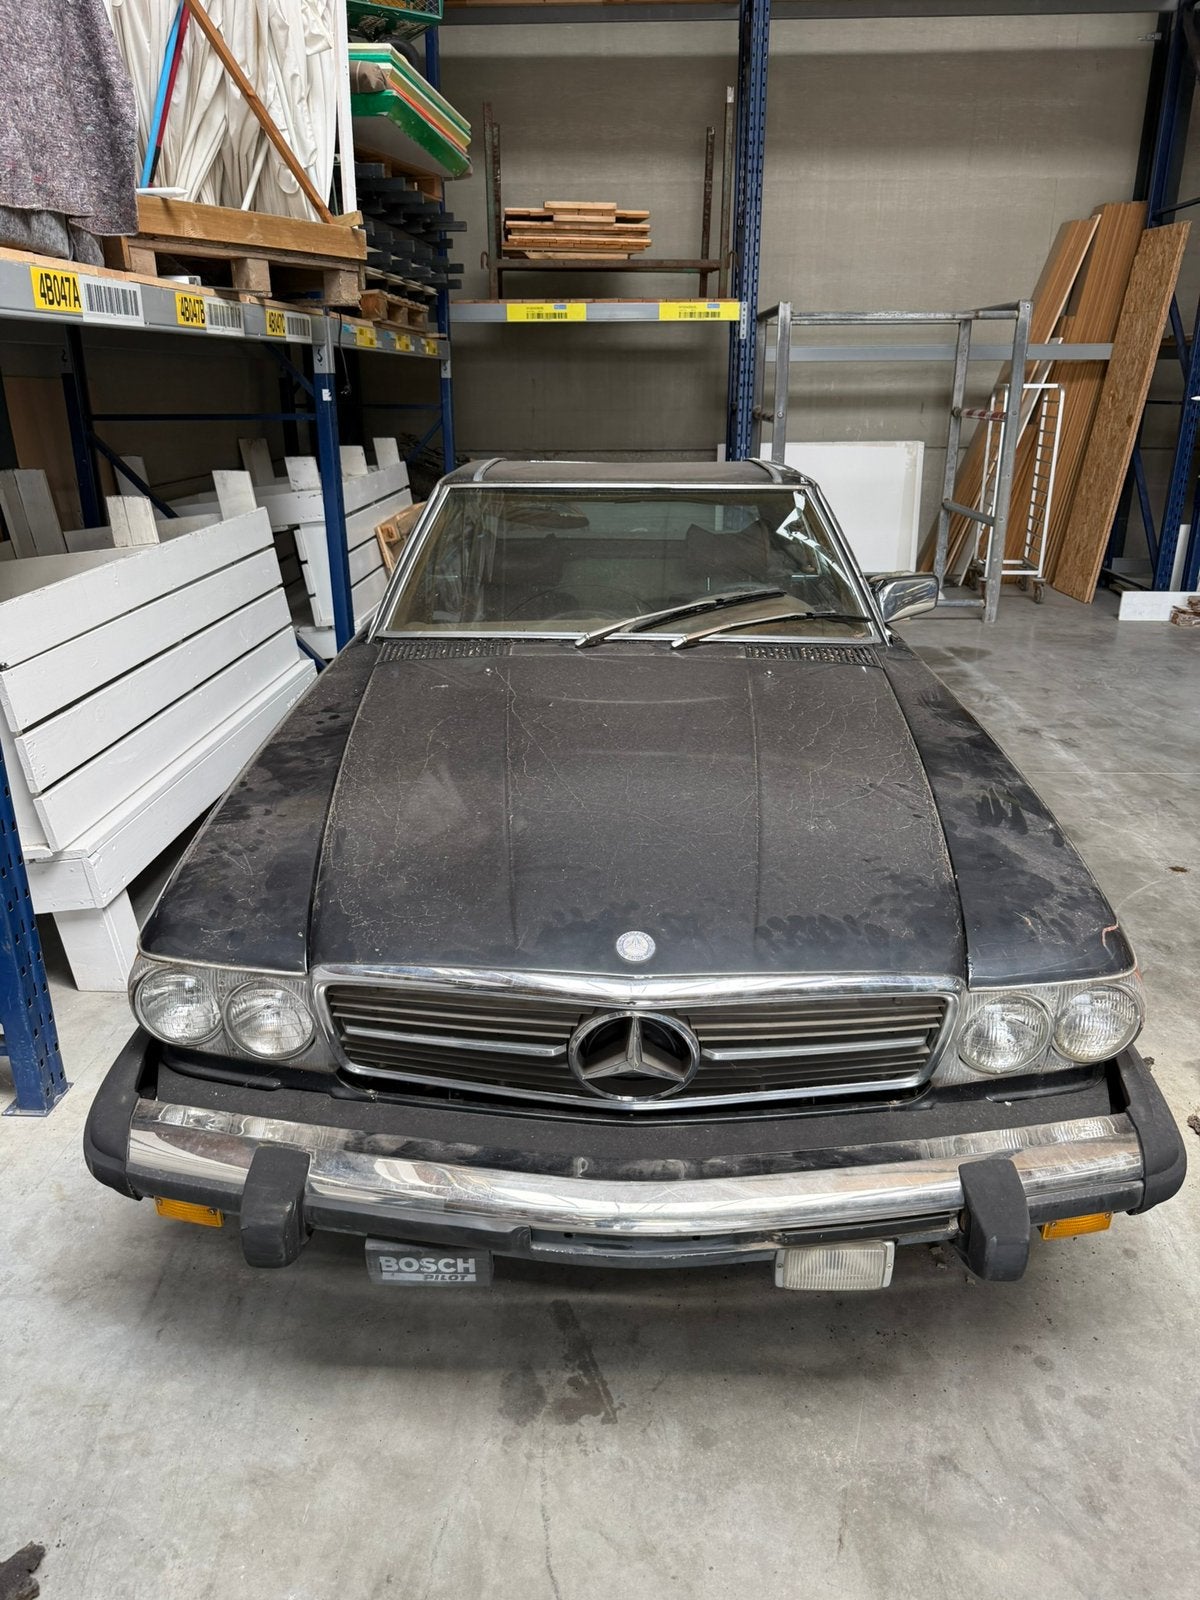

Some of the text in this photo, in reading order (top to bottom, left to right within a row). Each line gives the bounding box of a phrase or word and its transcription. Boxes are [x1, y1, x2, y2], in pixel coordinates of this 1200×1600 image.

[39, 272, 82, 309] 4B047A
[180, 296, 206, 324] 4B047B
[379, 1256, 476, 1273] BOSCH
